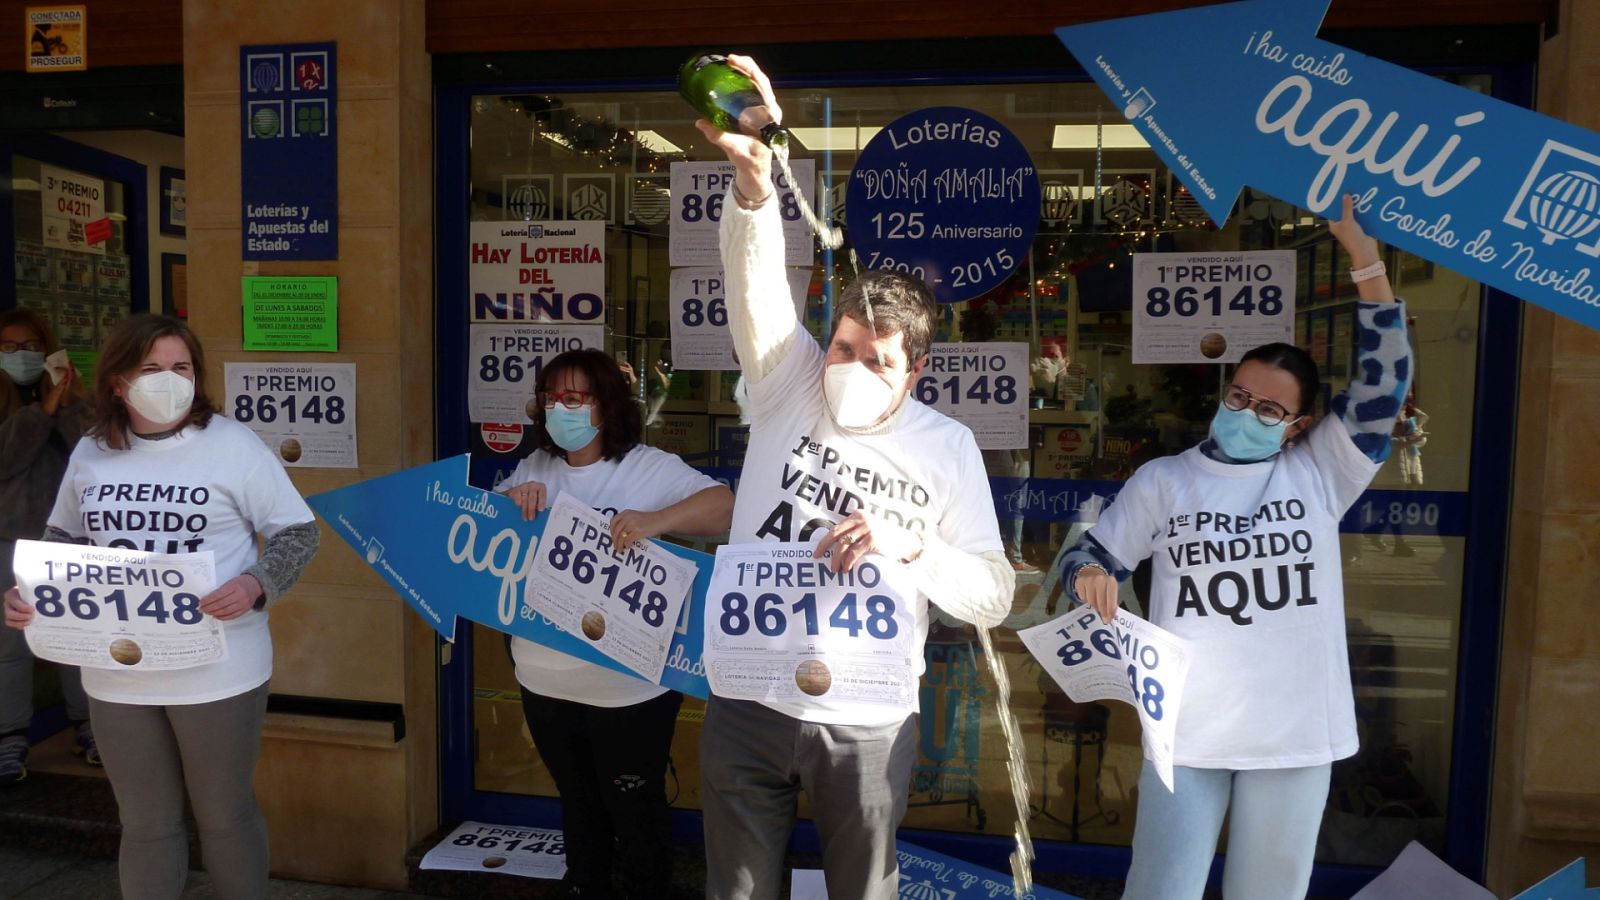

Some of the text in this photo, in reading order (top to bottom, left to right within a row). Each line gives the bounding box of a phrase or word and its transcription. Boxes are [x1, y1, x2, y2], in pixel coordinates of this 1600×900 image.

[31, 11, 81, 20] CONECTADA
[31, 57, 82, 67] PROSEGUR
[888, 118, 1001, 151] Loterías
[1095, 55, 1125, 91] Loterías
[1145, 115, 1178, 156] Apuestas
[1177, 154, 1192, 171] del
[1190, 168, 1217, 201] Estado
[1255, 74, 1486, 213] aquí
[62, 181, 99, 201] PREMIO
[58, 198, 91, 218] 04211
[248, 203, 309, 220] Loterías y
[682, 193, 802, 223] 868
[248, 220, 329, 238] Apuestas del
[544, 228, 576, 236] Nacional
[871, 212, 1023, 239] 125 Aniversario
[1380, 196, 1460, 249] Gordo
[1464, 229, 1498, 263] de
[248, 237, 290, 251] Estado
[951, 248, 1015, 288] 2015
[1224, 256, 1244, 264] AQUÍ
[519, 269, 553, 284] DEL
[1175, 264, 1272, 284] PREMIO
[474, 287, 603, 320] NIÑO
[1146, 285, 1284, 317] 86148
[504, 337, 582, 352] PREMIO
[296, 366, 312, 375] AQUÍ
[257, 375, 336, 393] PREMIO
[916, 375, 1017, 405] 6148
[234, 395, 346, 424] 86148
[791, 435, 822, 458] 1er
[98, 484, 210, 506] PREMIO
[83, 511, 208, 533] ENDIDO
[1168, 498, 1307, 539] 1er PREMIO
[1362, 501, 1440, 527] 1.890
[81, 552, 146, 566] VENDIDO AQUÍ
[771, 549, 812, 559] VENDIDO
[1168, 529, 1313, 568] VENDIDO
[66, 562, 184, 588] PREMIO
[338, 514, 363, 541] Loterías
[381, 559, 409, 590] Apuestas
[409, 588, 420, 601] del
[420, 599, 442, 623] Estado
[548, 535, 668, 627] 86148
[737, 562, 755, 587] 1er
[1176, 556, 1318, 626] AQUÍ
[34, 585, 204, 625] 86148
[720, 592, 898, 640] 86148
[453, 834, 566, 856] 86148
